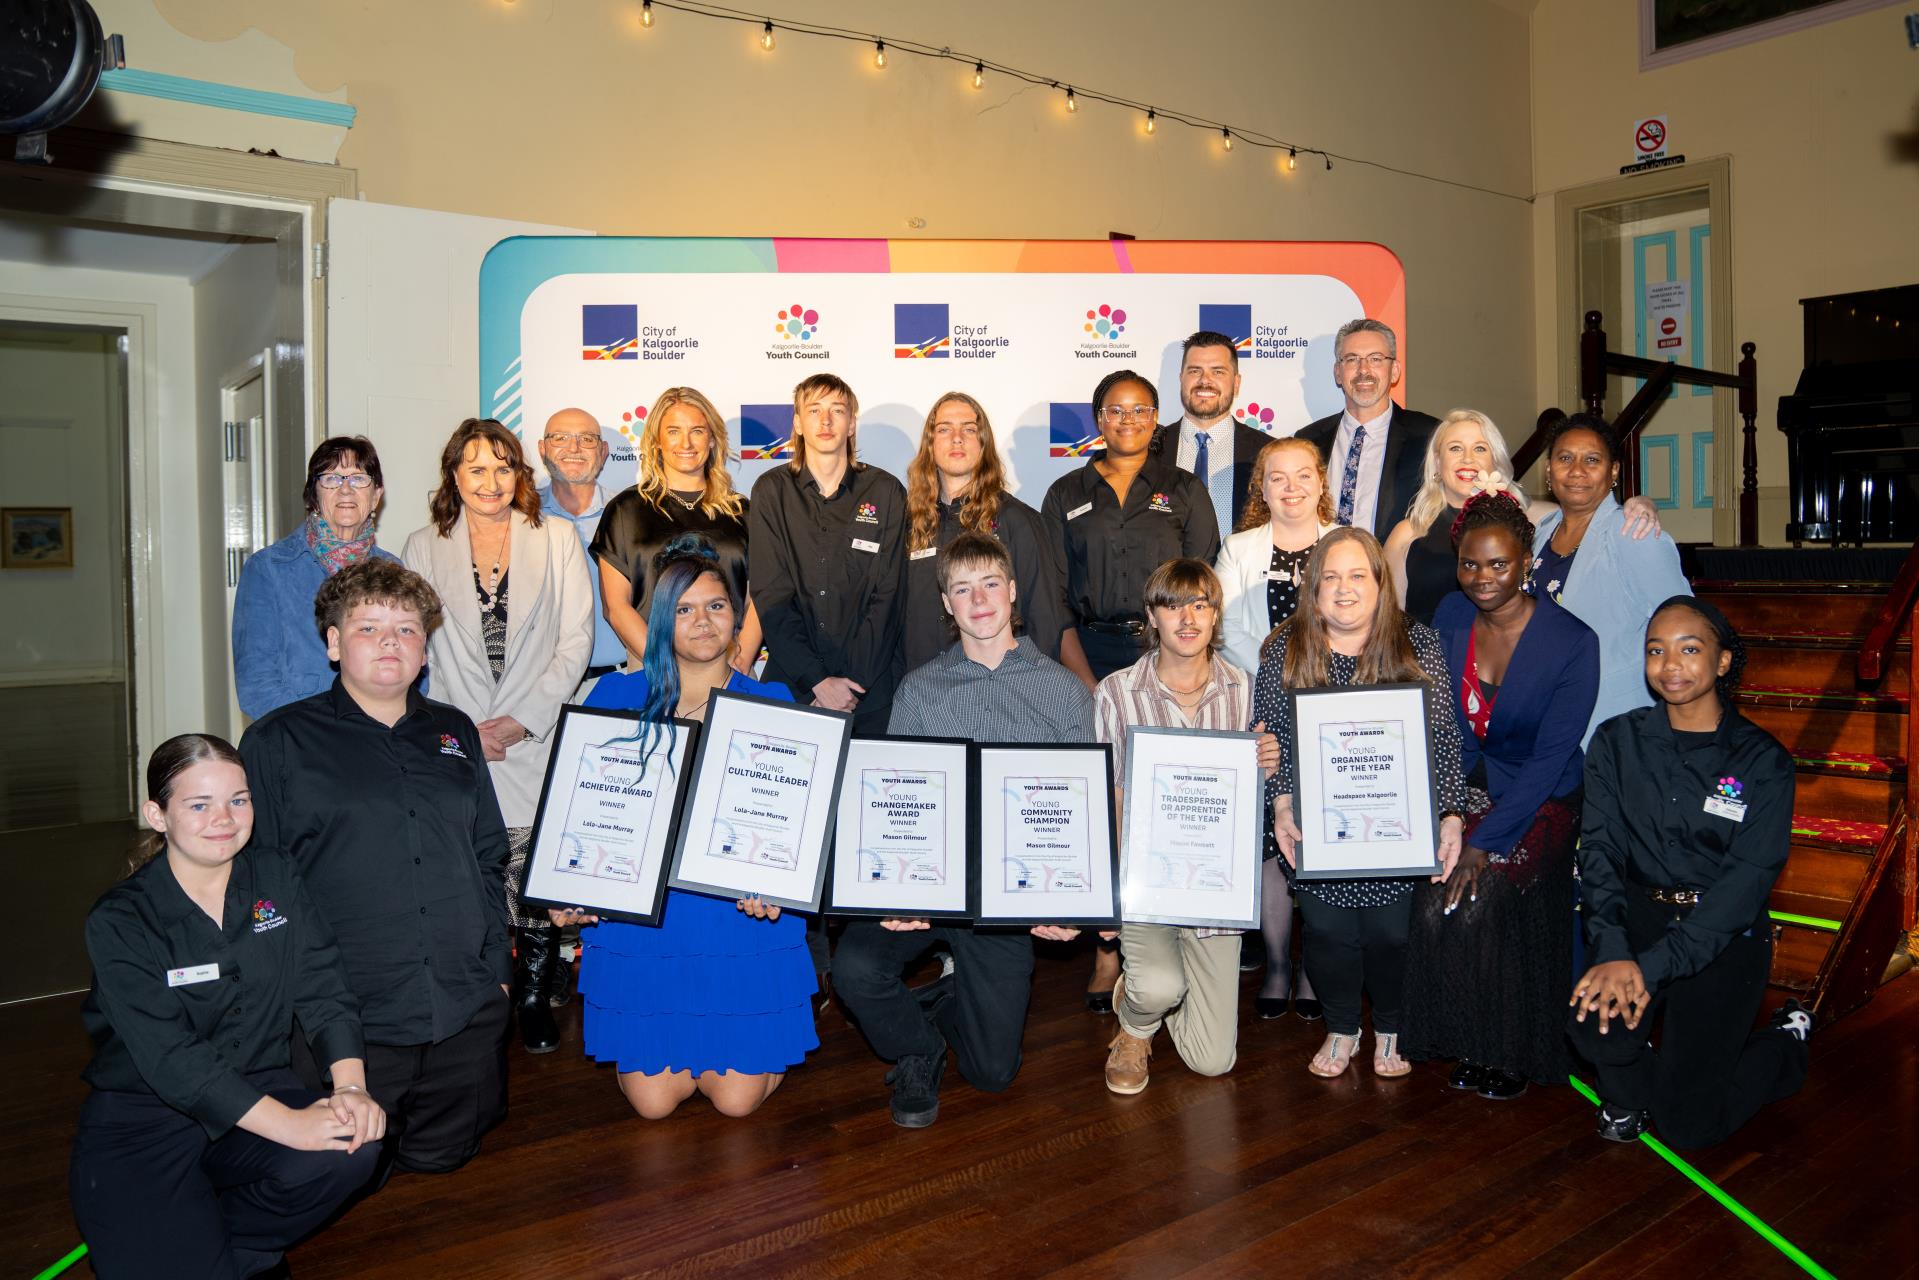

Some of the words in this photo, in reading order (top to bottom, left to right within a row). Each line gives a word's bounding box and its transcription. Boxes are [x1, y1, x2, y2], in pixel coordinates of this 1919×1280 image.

[642, 326, 664, 339] City
[665, 326, 677, 336] of
[954, 325, 975, 338] City
[977, 325, 988, 335] of
[1256, 326, 1276, 338] City
[1278, 326, 1288, 336] of
[642, 338, 699, 349] Kalgoorlie
[954, 337, 1010, 348] Kalgoorlie
[1256, 338, 1309, 349] Kalgoorlie
[642, 351, 686, 360] Boulder
[766, 352, 793, 360] Youth
[794, 351, 830, 360] Council
[954, 349, 996, 359] Boulder
[1074, 351, 1101, 359] Youth
[1102, 350, 1137, 359] Council
[1256, 349, 1296, 359] Boulder
[611, 454, 637, 462] Youth
[750, 742, 770, 751] YOUTH
[771, 747, 797, 756] AWARDS
[1348, 747, 1376, 755] YOUNG
[601, 756, 619, 764] YOUTH
[620, 759, 644, 767] AWARD
[1331, 755, 1394, 765] ORGANISATION
[755, 762, 784, 774] YOUNG
[1337, 765, 1349, 773] OF
[604, 775, 631, 786] YOUNG
[728, 767, 773, 781] CULTURAL
[774, 774, 809, 788] LEADER
[580, 781, 621, 794] ACHIEVER
[622, 787, 653, 798] AWARD
[751, 787, 780, 798] WINNER
[1179, 787, 1208, 796] YOUNG
[1161, 795, 1228, 806] TRADESPERSON
[1333, 793, 1366, 801] Headspace
[599, 801, 626, 810] WINNER
[871, 802, 937, 810] CHANGEMAKER
[1161, 804, 1174, 812] OR
[1174, 805, 1228, 815] APPRENTICE
[766, 811, 789, 822] Murray
[1021, 809, 1073, 817] COMMUNITY
[889, 819, 917, 827] WINNER
[1024, 817, 1070, 825] CHAMPION
[1167, 813, 1178, 821] OF
[1180, 814, 1196, 822] THE
[1198, 815, 1220, 824] YEAR
[1180, 824, 1207, 832] WINNER
